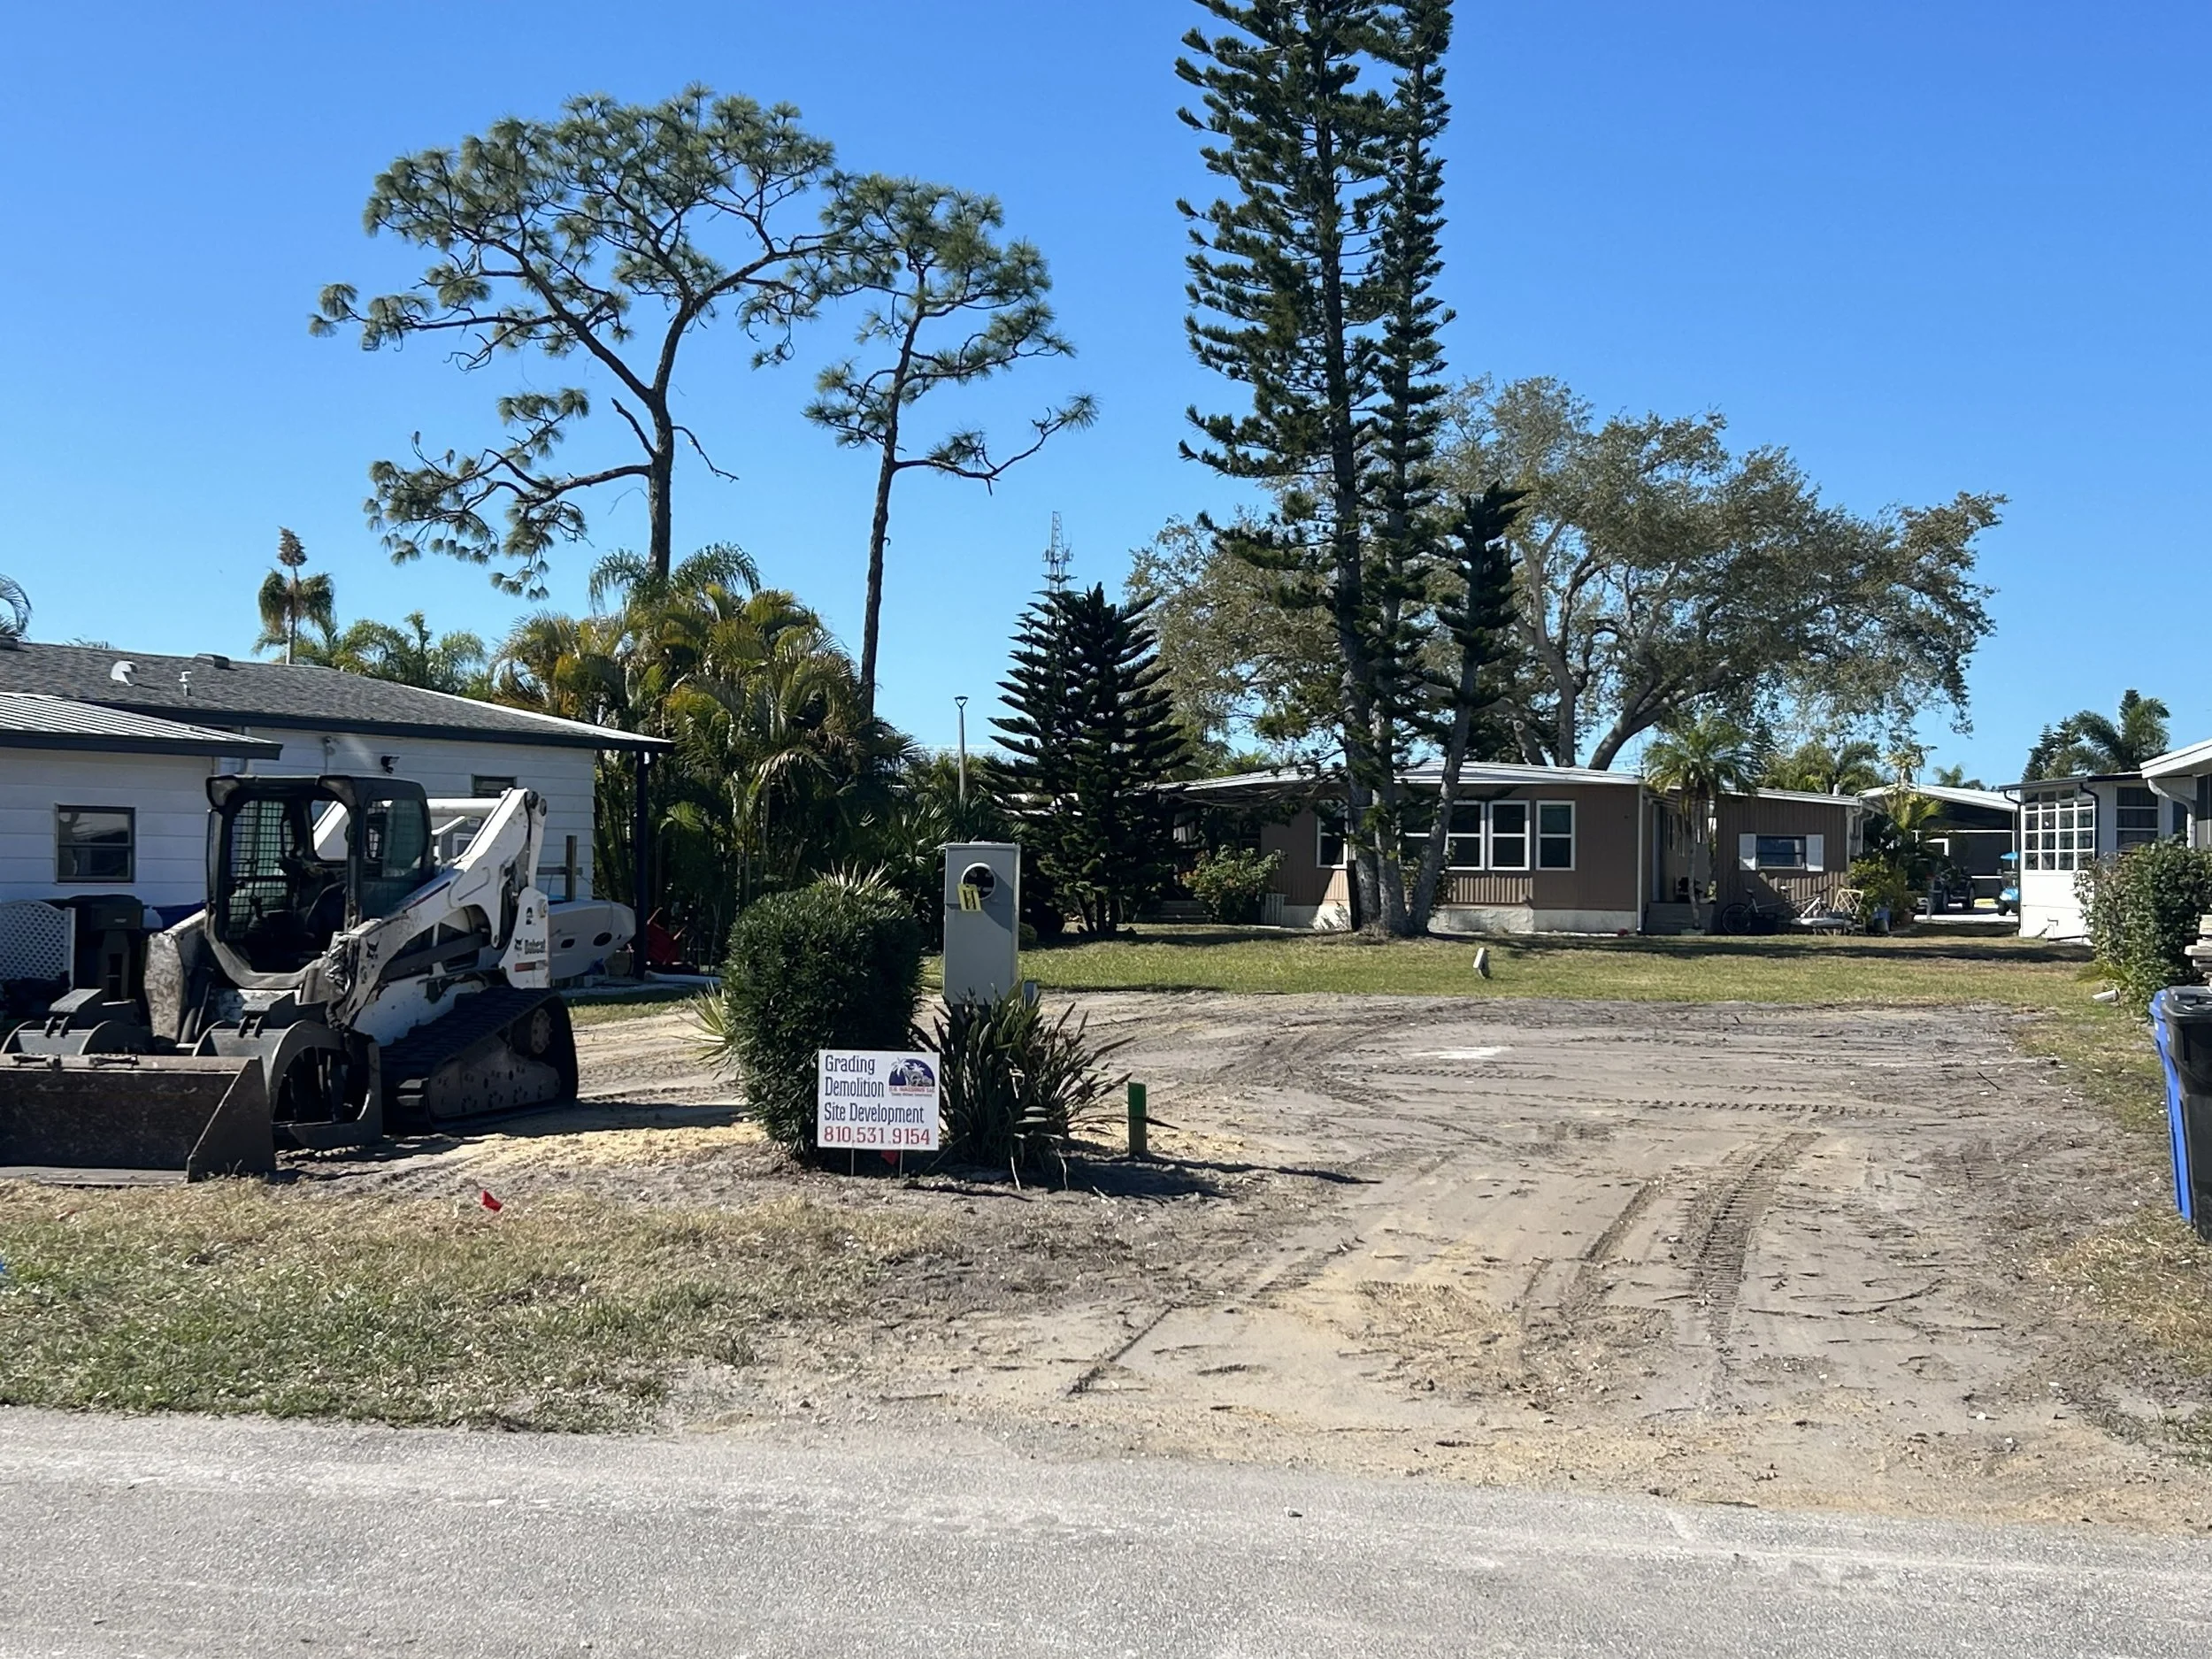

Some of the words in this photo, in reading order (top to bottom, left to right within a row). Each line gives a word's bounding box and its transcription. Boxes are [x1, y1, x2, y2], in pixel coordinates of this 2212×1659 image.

[825, 1055, 875, 1075] Grading
[825, 1077, 884, 1097] Demolition
[825, 1102, 846, 1121] Site
[849, 1103, 924, 1125] Development
[824, 1126, 929, 1145] 810.531.9154
